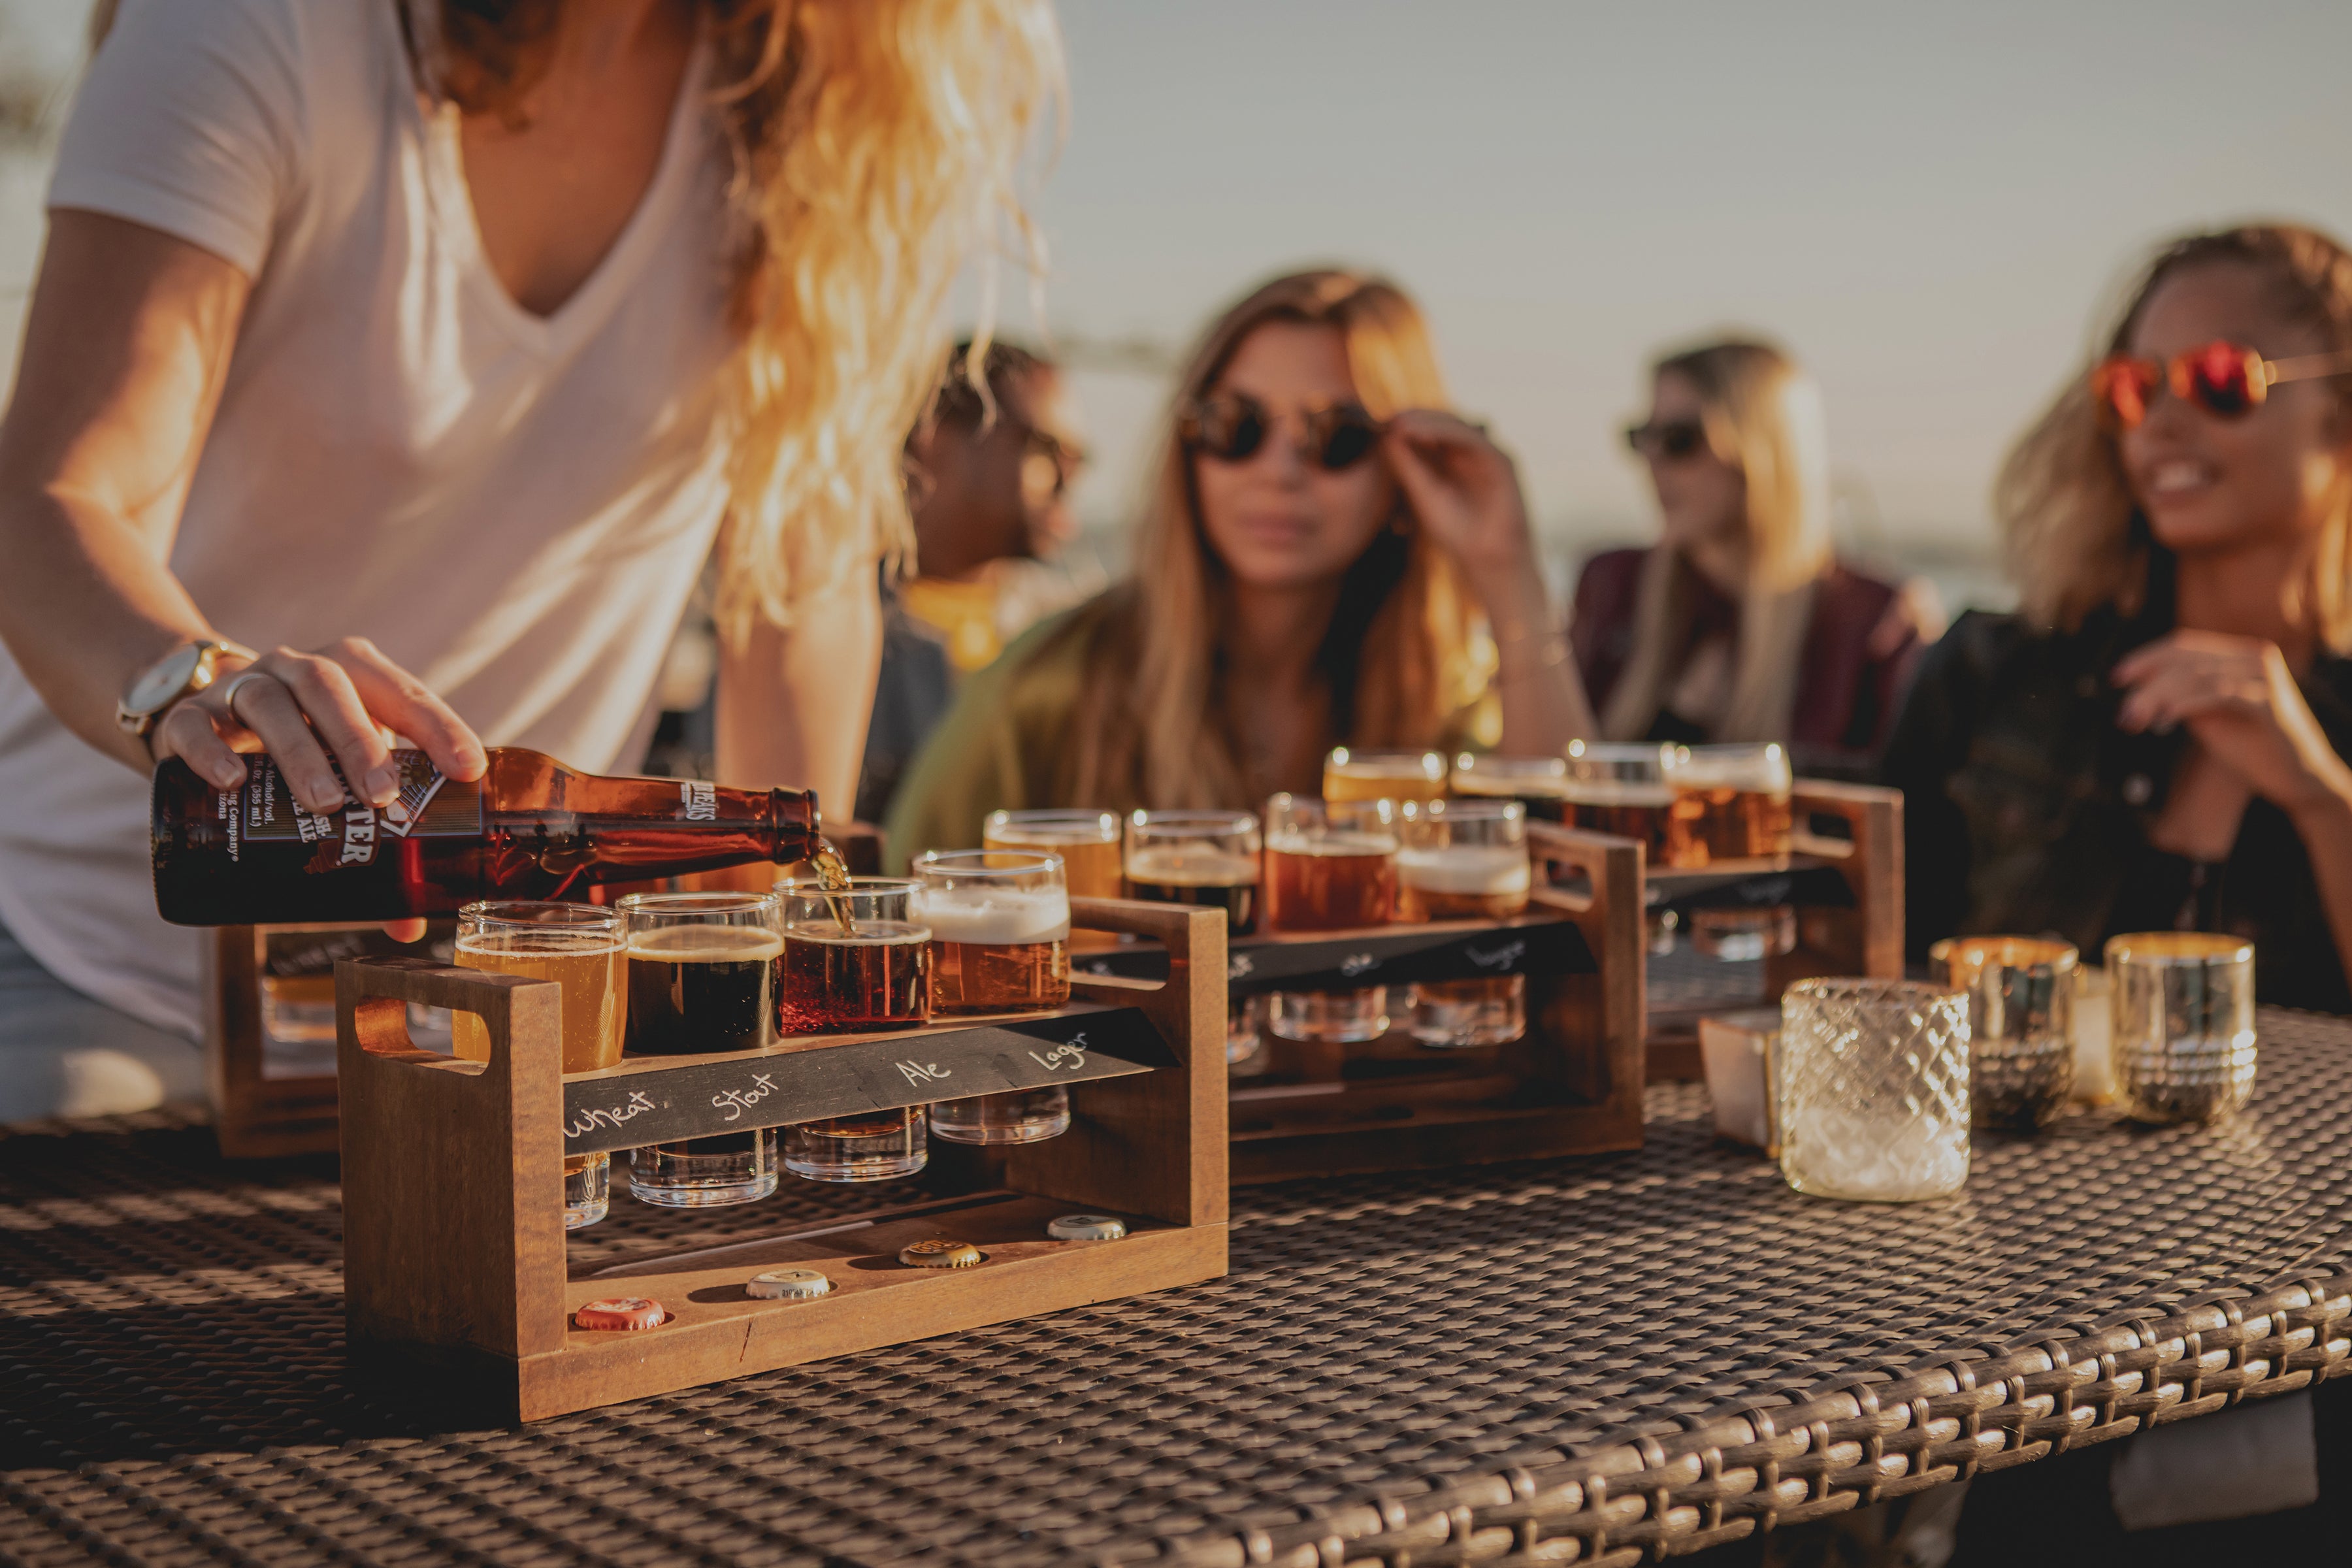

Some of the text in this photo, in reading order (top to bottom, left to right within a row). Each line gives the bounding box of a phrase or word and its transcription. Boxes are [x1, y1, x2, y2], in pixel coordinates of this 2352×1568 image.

[686, 792, 717, 821] PEAKS
[296, 818, 318, 843] ALE
[712, 1074, 779, 1120] Stout
[895, 1060, 951, 1087] Ale
[1028, 1032, 1087, 1070] Lager
